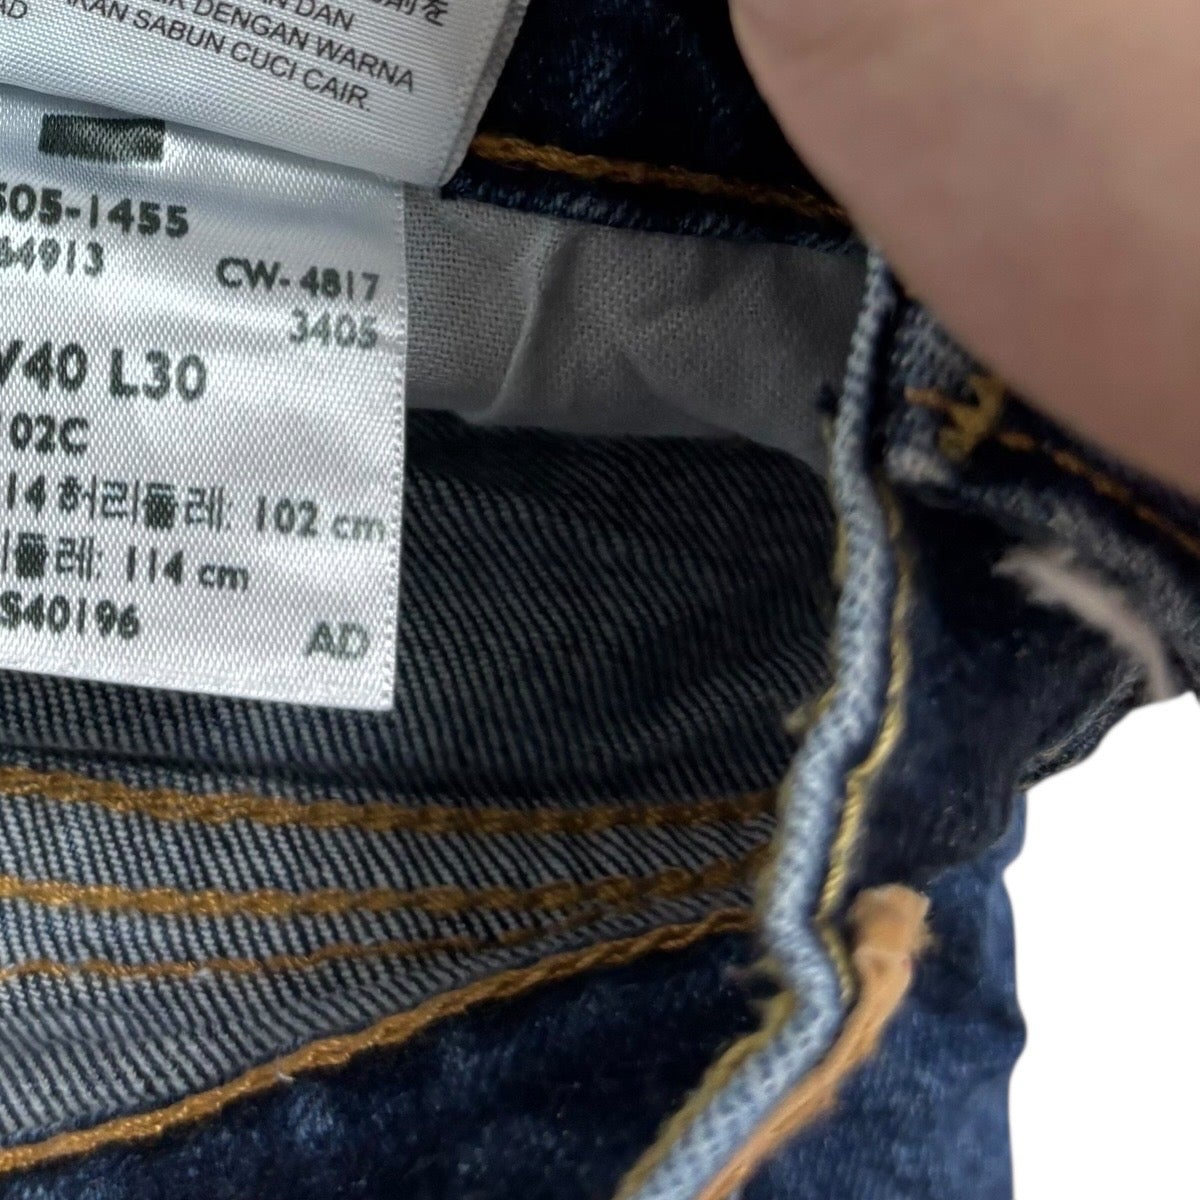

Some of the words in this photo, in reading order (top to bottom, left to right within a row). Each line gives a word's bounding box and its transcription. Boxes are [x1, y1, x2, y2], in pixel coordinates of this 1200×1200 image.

[132, 8, 226, 54] SABUN
[230, 41, 298, 82] CUCI
[303, 68, 371, 112] CAIR.
[315, 35, 414, 92] WARNA
[290, 306, 378, 349] 3405
[109, 349, 207, 402] L30
[256, 495, 318, 538] 102
[332, 514, 387, 542] cm
[126, 545, 184, 586] 114
[198, 563, 249, 592] cm
[0, 589, 140, 640] S40196
[306, 621, 371, 660] AD
